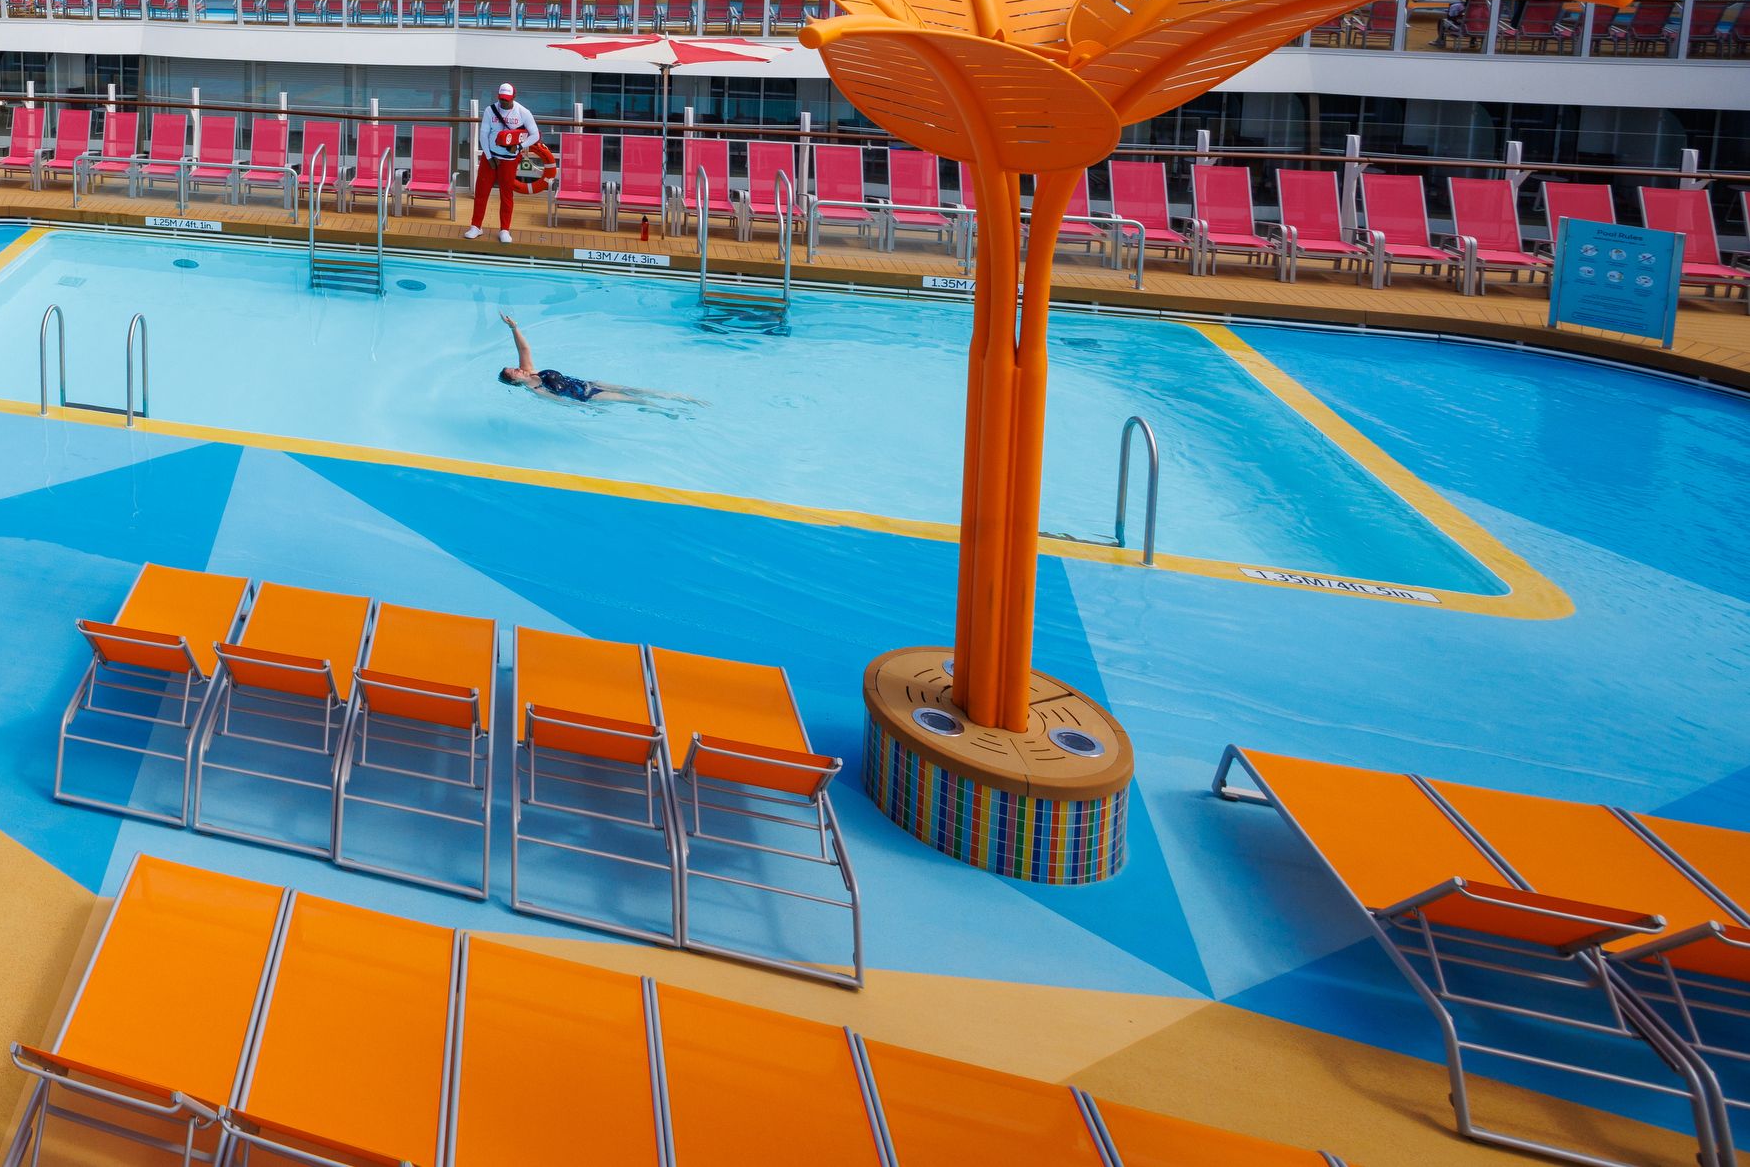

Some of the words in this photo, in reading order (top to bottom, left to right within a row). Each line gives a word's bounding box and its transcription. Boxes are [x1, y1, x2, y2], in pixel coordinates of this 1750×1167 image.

[153, 218, 177, 227] 1.25M
[186, 221, 199, 229] 4ft.
[1597, 229, 1617, 238] Pool
[1619, 233, 1643, 241] Rules
[588, 251, 611, 260] 1.3M
[621, 254, 638, 263] 4ft.
[640, 255, 659, 264] 3in.
[931, 278, 967, 289] 1.35M
